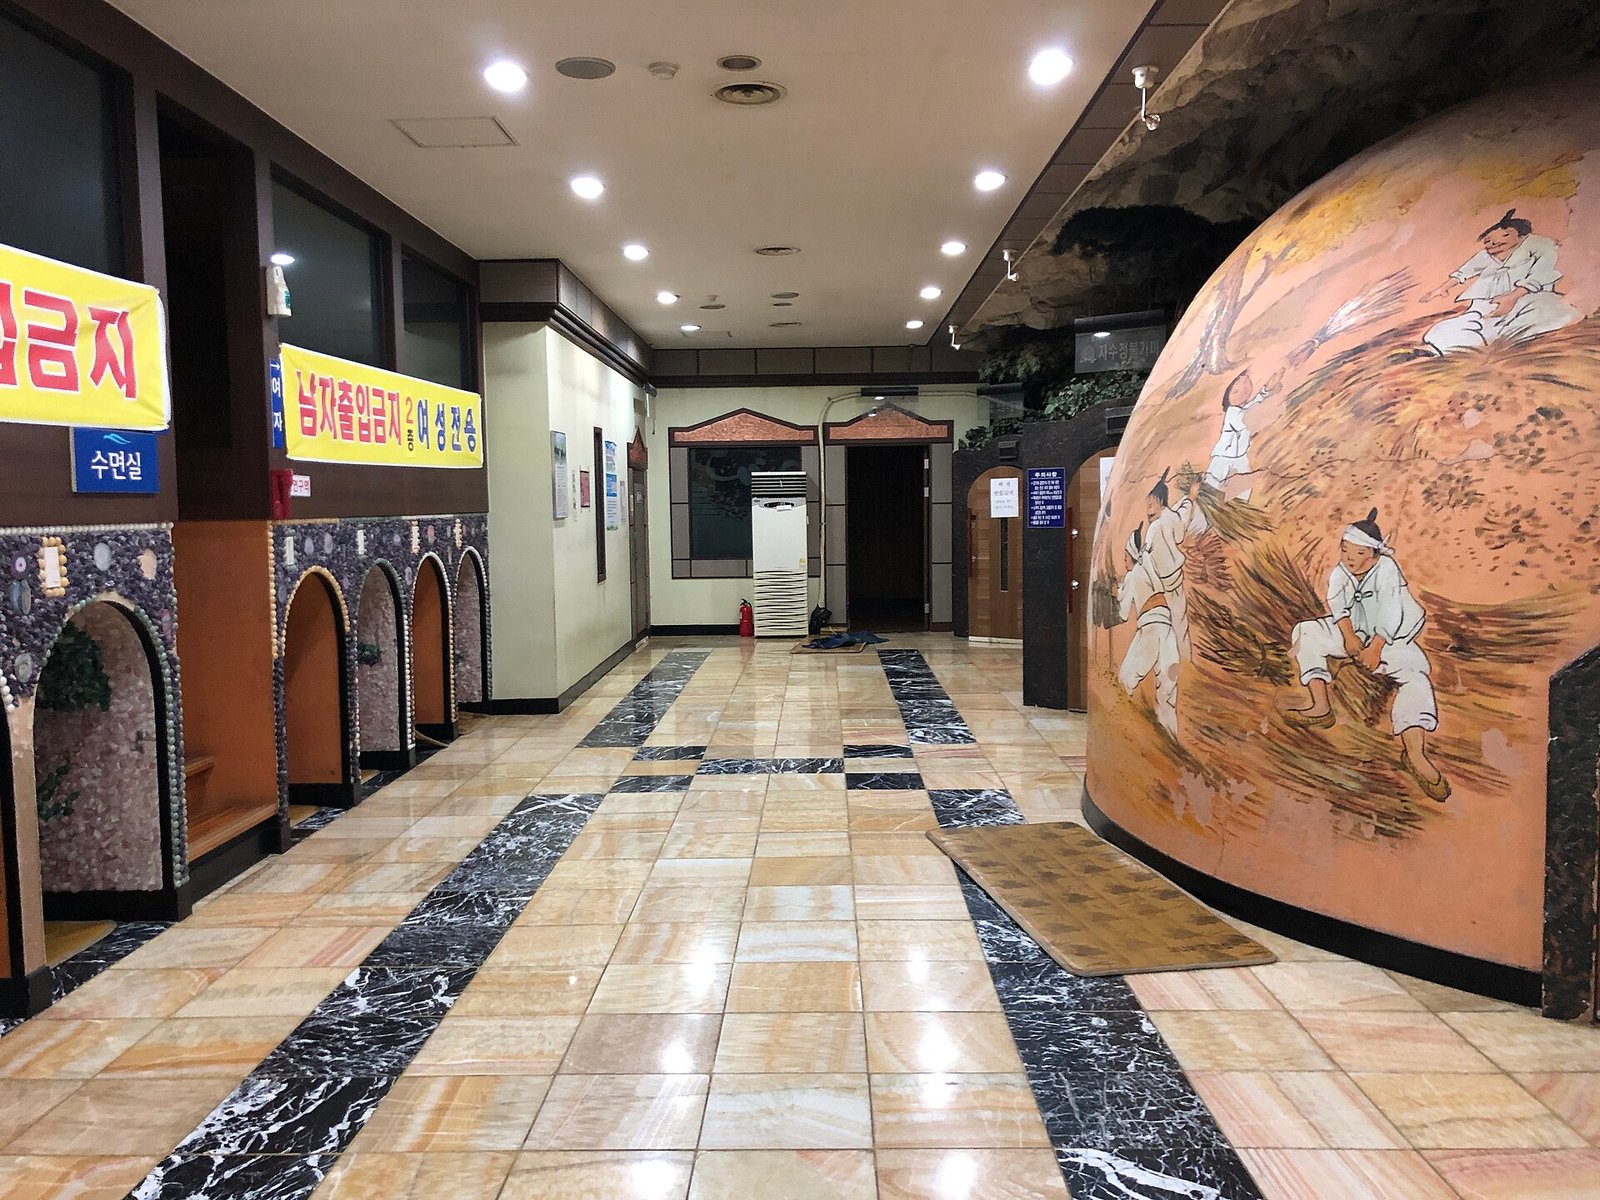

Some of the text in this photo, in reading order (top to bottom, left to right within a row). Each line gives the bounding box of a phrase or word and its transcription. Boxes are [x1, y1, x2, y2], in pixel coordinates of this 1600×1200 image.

[271, 377, 283, 432] 여자
[296, 371, 401, 446] 남자출입금지
[90, 450, 142, 480] 수면실
